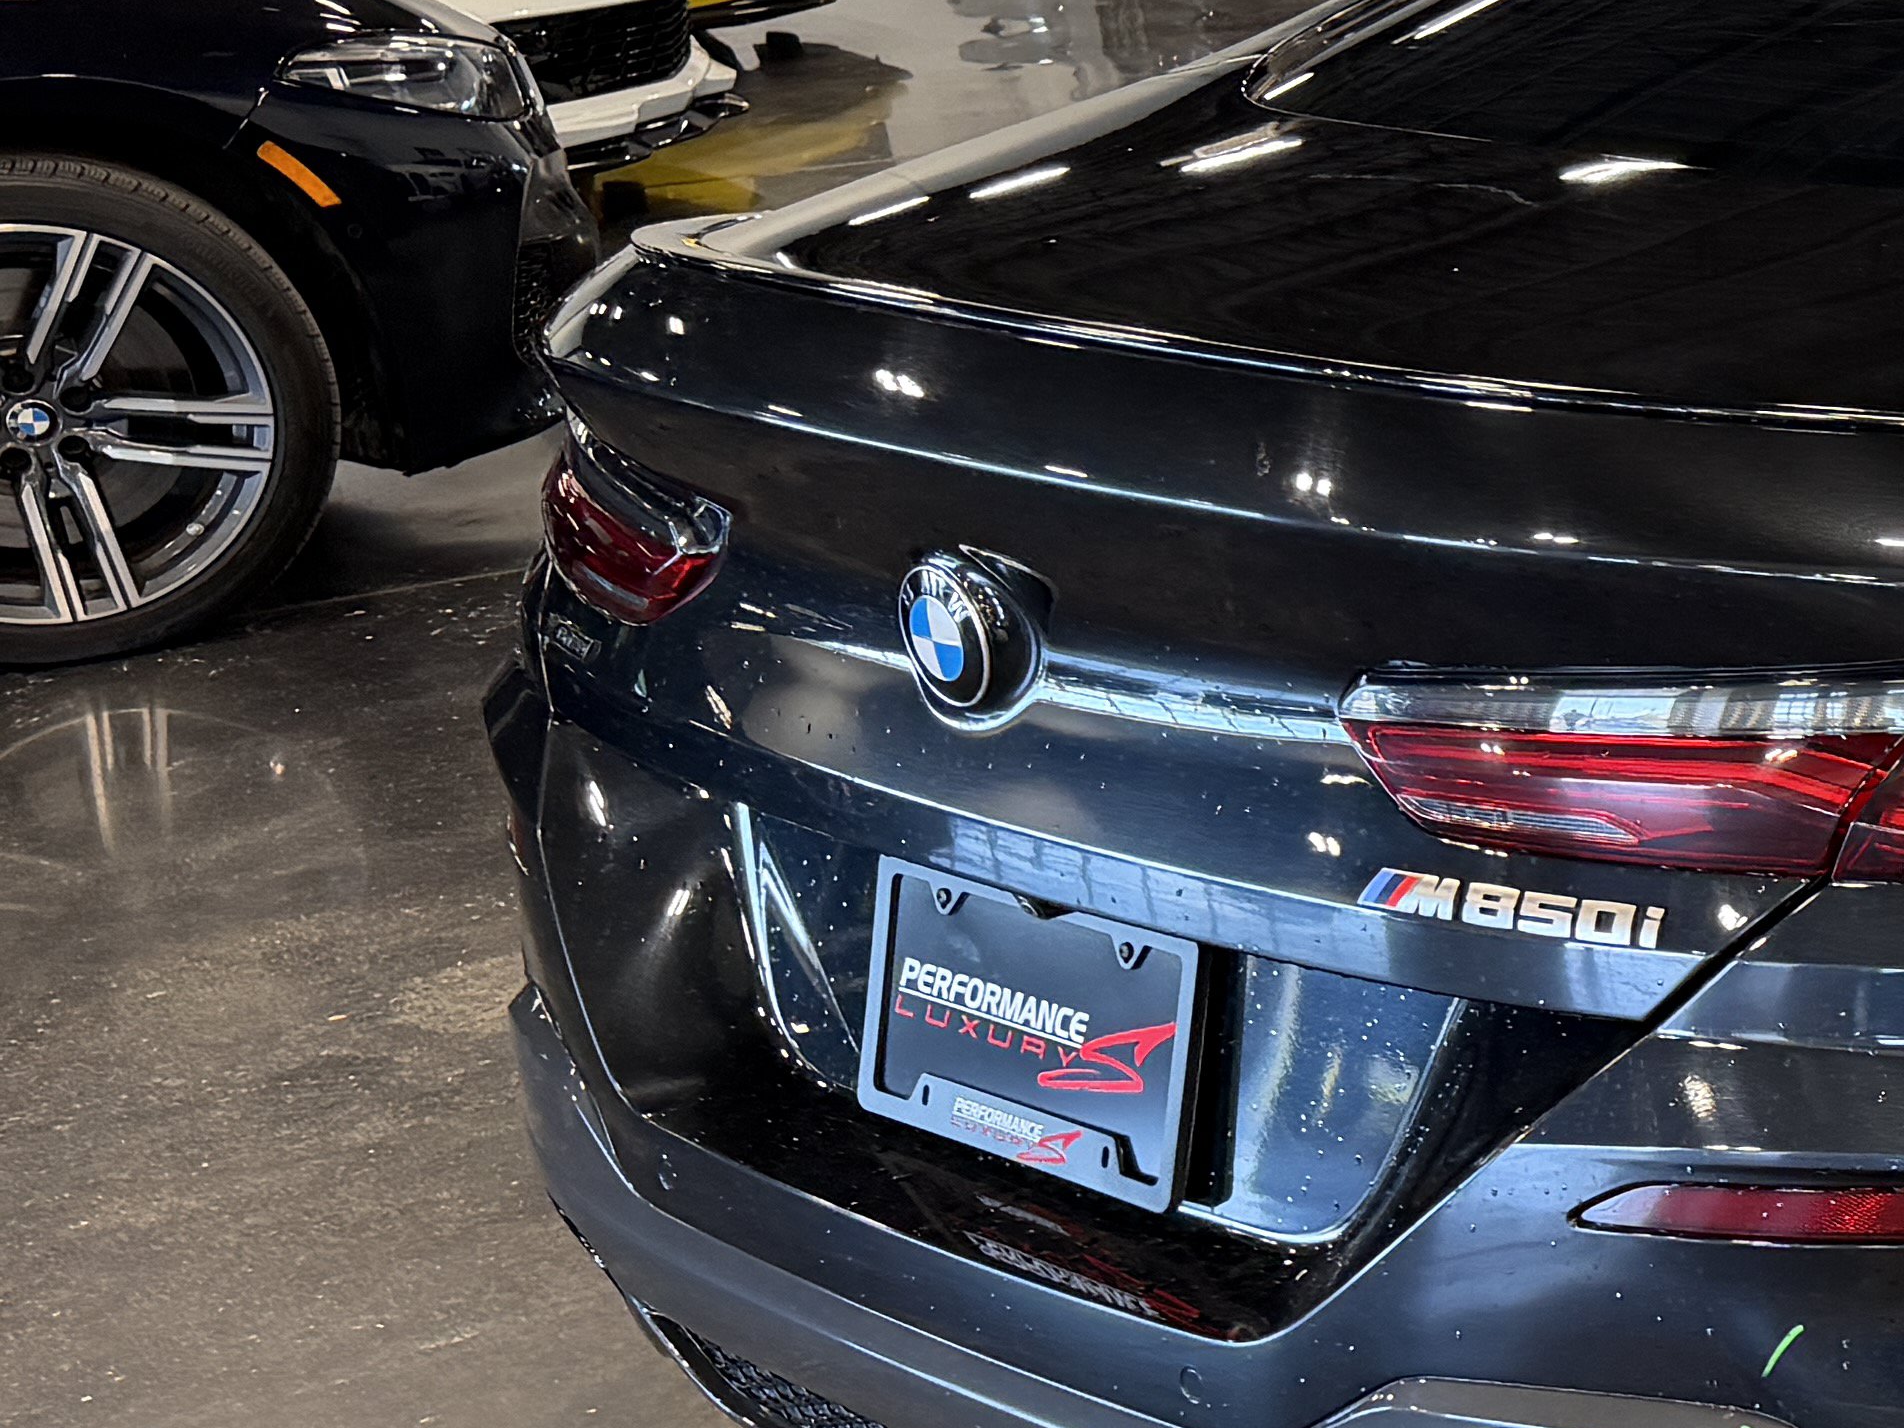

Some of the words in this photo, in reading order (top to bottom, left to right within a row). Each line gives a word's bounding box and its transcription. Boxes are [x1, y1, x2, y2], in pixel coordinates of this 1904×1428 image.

[1393, 875, 1666, 950] M850i
[893, 996, 1078, 1068] LUXURY
[899, 957, 1090, 1041] PERFORMANCE
[952, 1096, 1046, 1138] PERFORMANCE
